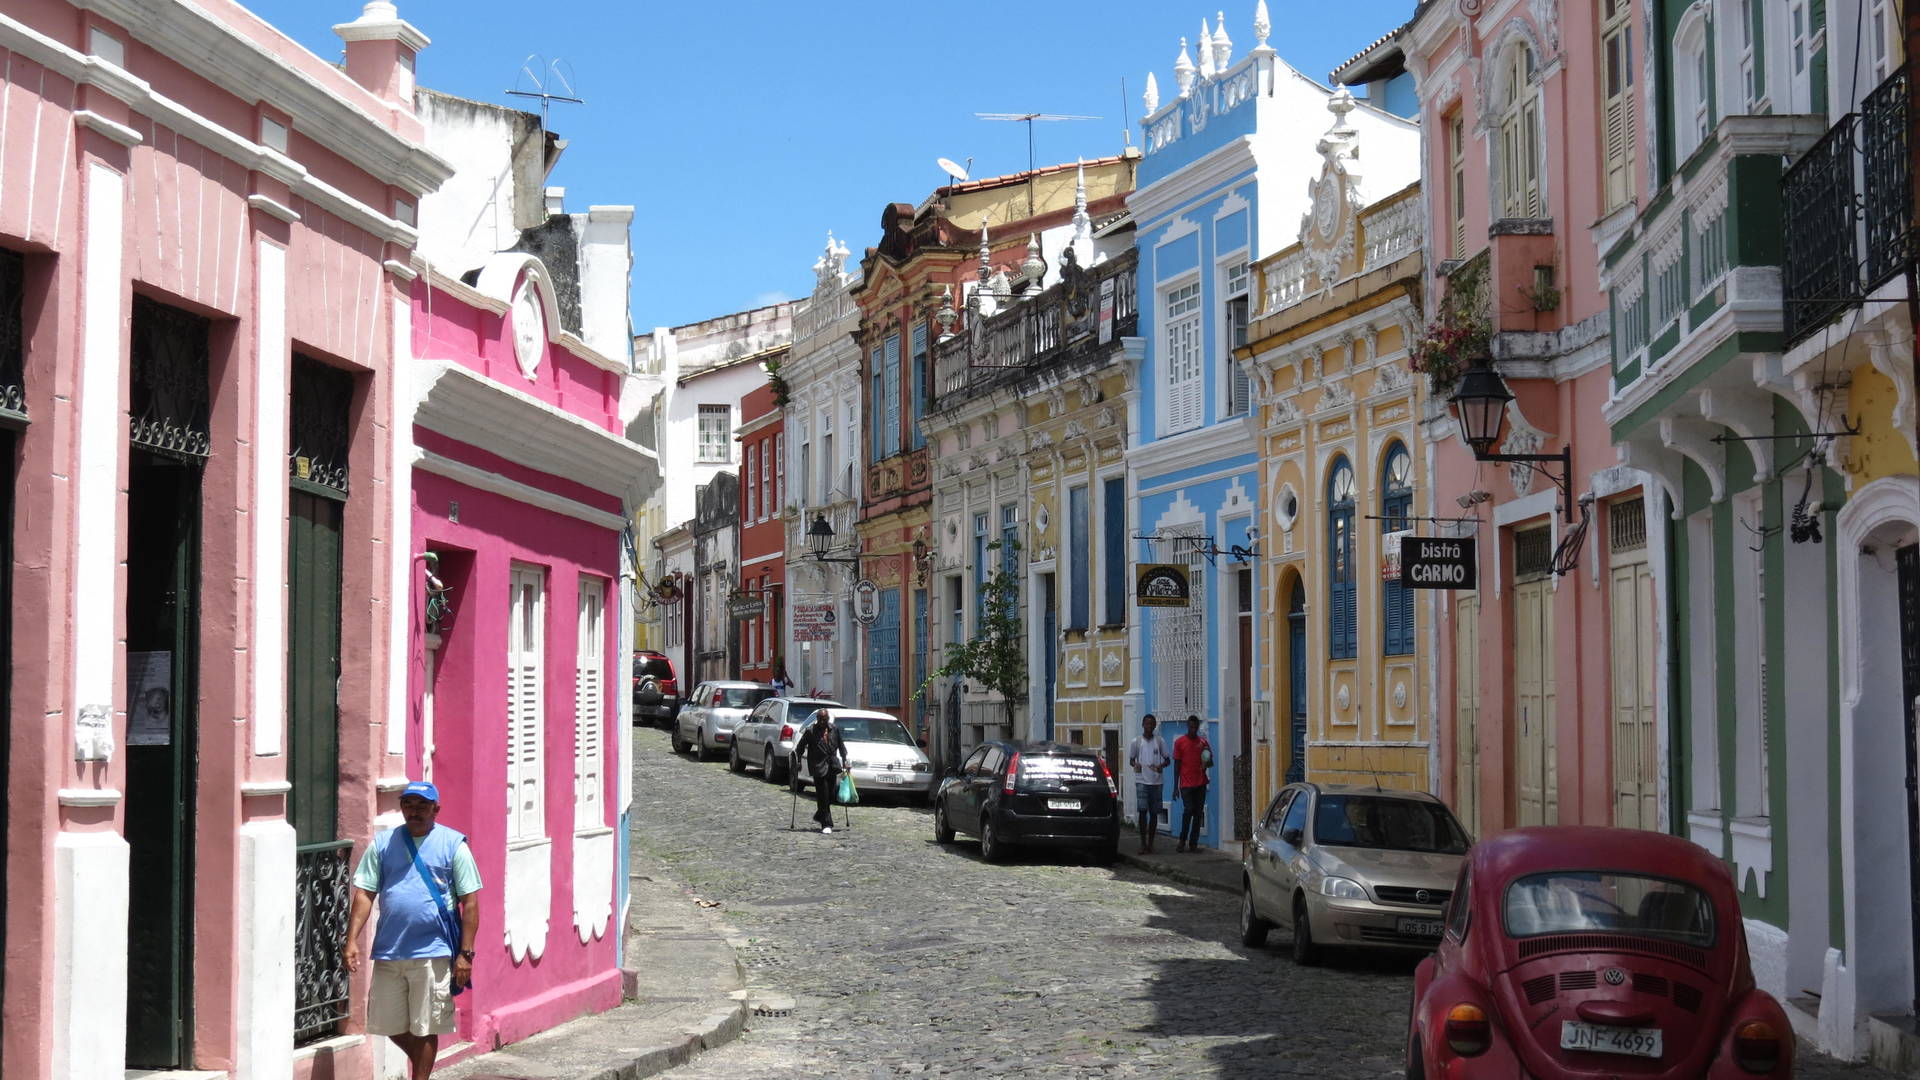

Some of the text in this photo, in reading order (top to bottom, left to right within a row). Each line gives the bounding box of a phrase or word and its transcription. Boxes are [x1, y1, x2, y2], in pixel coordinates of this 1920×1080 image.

[1421, 542, 1461, 559] bistrô
[1411, 563, 1465, 583] CARMO
[1066, 759, 1095, 767] TROCO
[1567, 1028, 1656, 1053] JNF 4699
